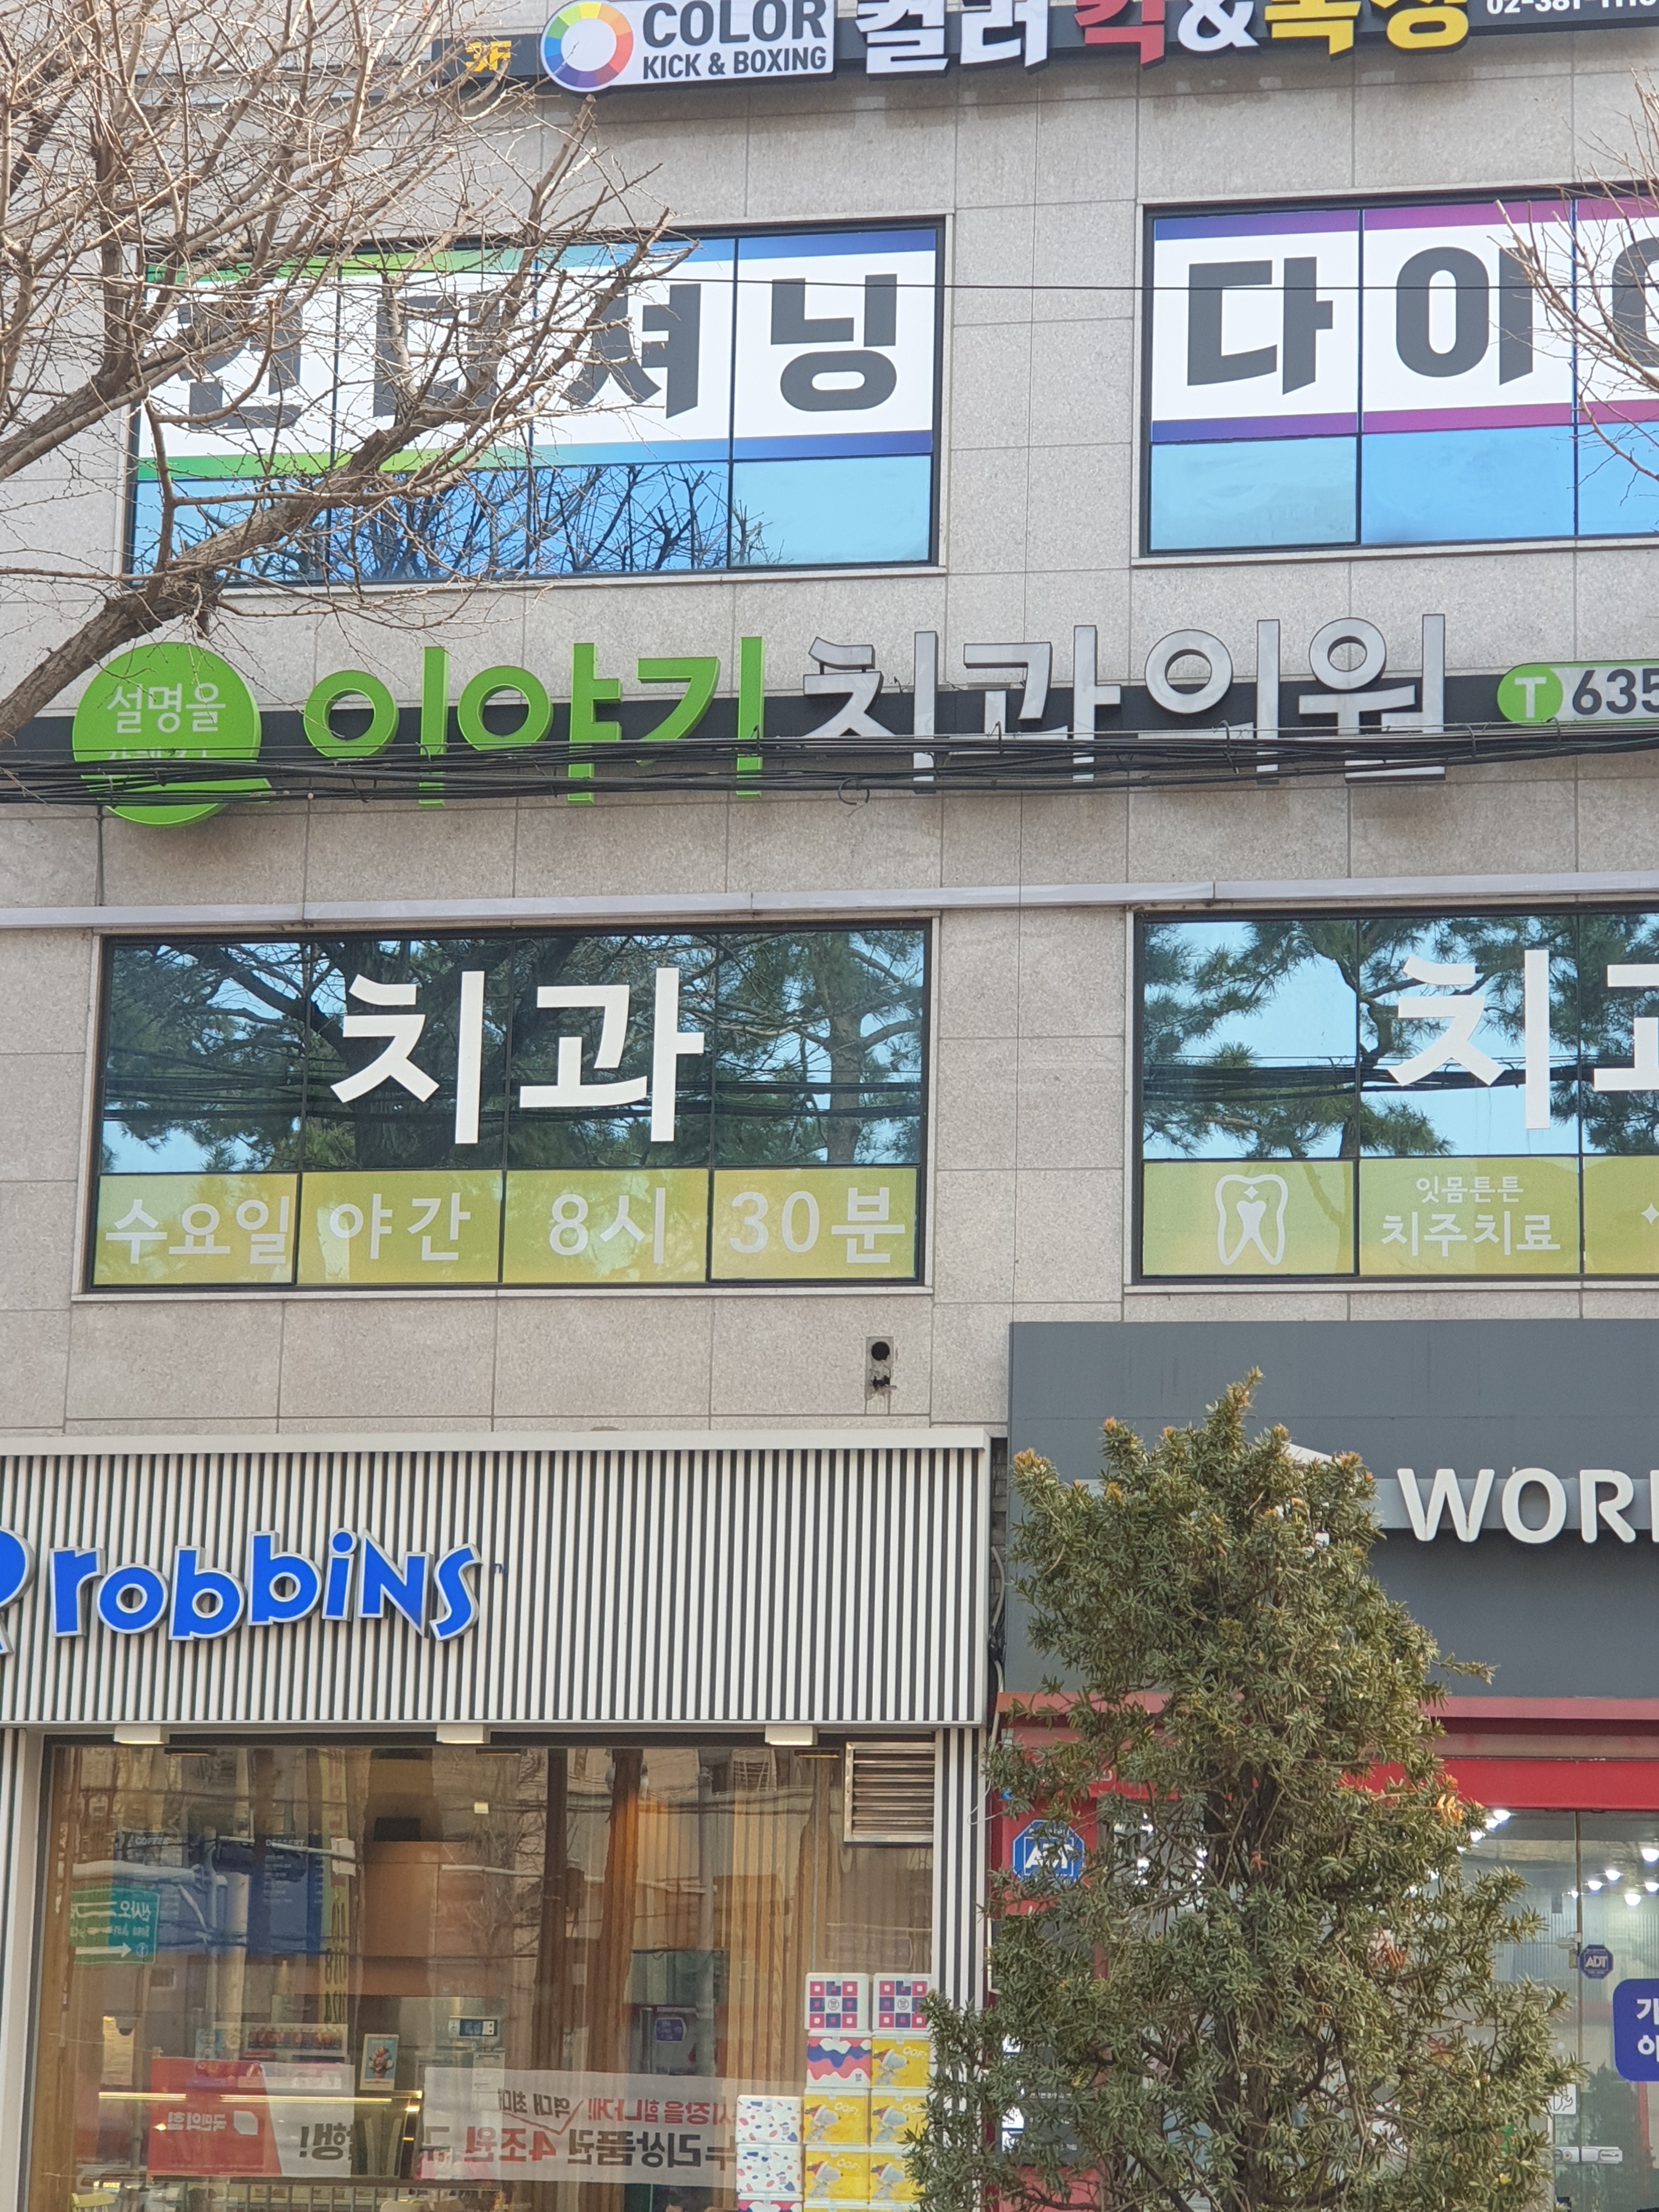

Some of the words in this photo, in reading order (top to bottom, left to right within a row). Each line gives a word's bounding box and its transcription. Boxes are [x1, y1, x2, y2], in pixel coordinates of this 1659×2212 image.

[642, 0, 827, 48] COLOR
[643, 52, 702, 80] KICK
[708, 53, 725, 76] &
[733, 46, 827, 74] BOXING
[107, 682, 226, 734] 설명을
[303, 636, 765, 806] 이야기
[803, 613, 1447, 782] 치과의원
[1514, 676, 1547, 719] T
[330, 967, 705, 1144] 치과
[1415, 1175, 1524, 1204] 잇몸튼튼
[105, 1196, 290, 1265] 수요일
[330, 1192, 472, 1261] 야간
[549, 1187, 667, 1265] 8시
[729, 1187, 906, 1265] 30분
[1380, 1210, 1561, 1257] 치주치료
[1396, 1467, 1659, 1544] WOR
[1584, 1955, 1608, 1968] ADT
